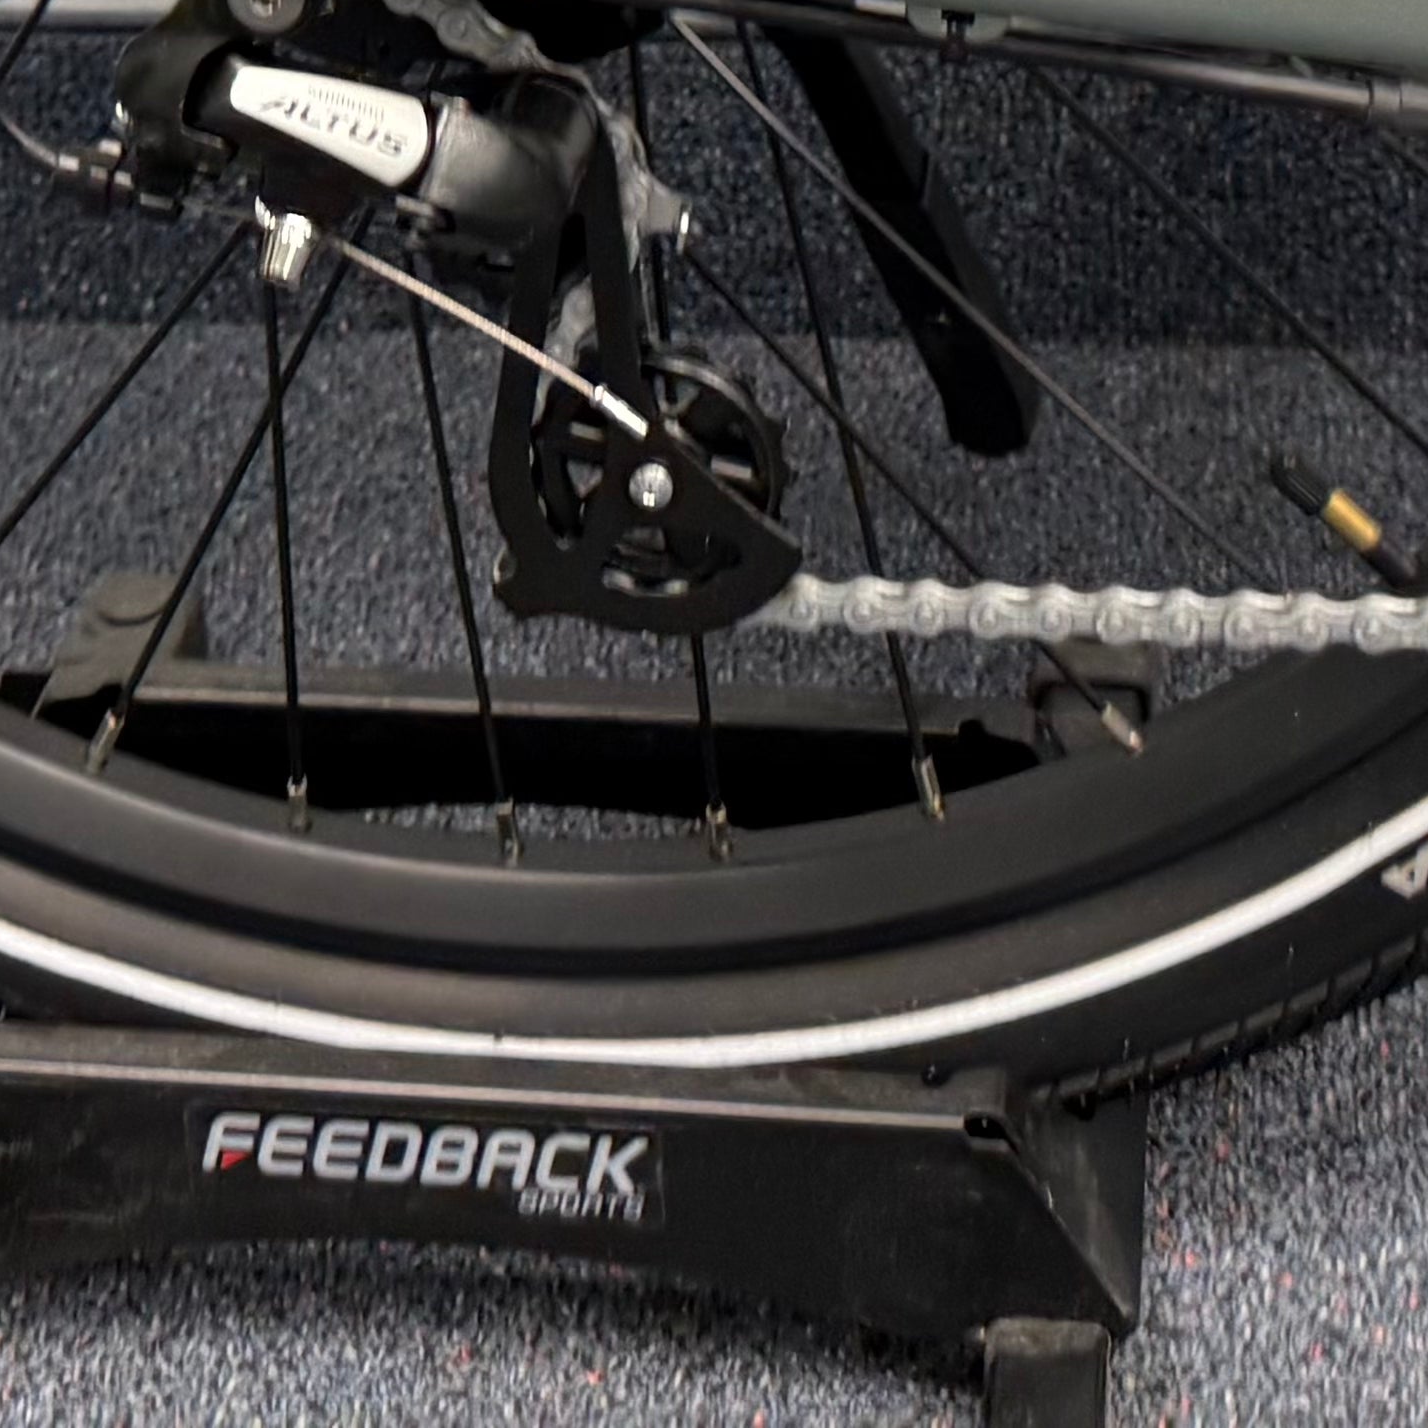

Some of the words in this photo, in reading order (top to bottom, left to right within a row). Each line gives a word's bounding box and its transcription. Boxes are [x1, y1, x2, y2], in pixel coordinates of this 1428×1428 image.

[259, 95, 409, 156] ALTUS
[202, 1112, 649, 1193] FEEDBACK
[517, 1187, 646, 1222] SPORTS
